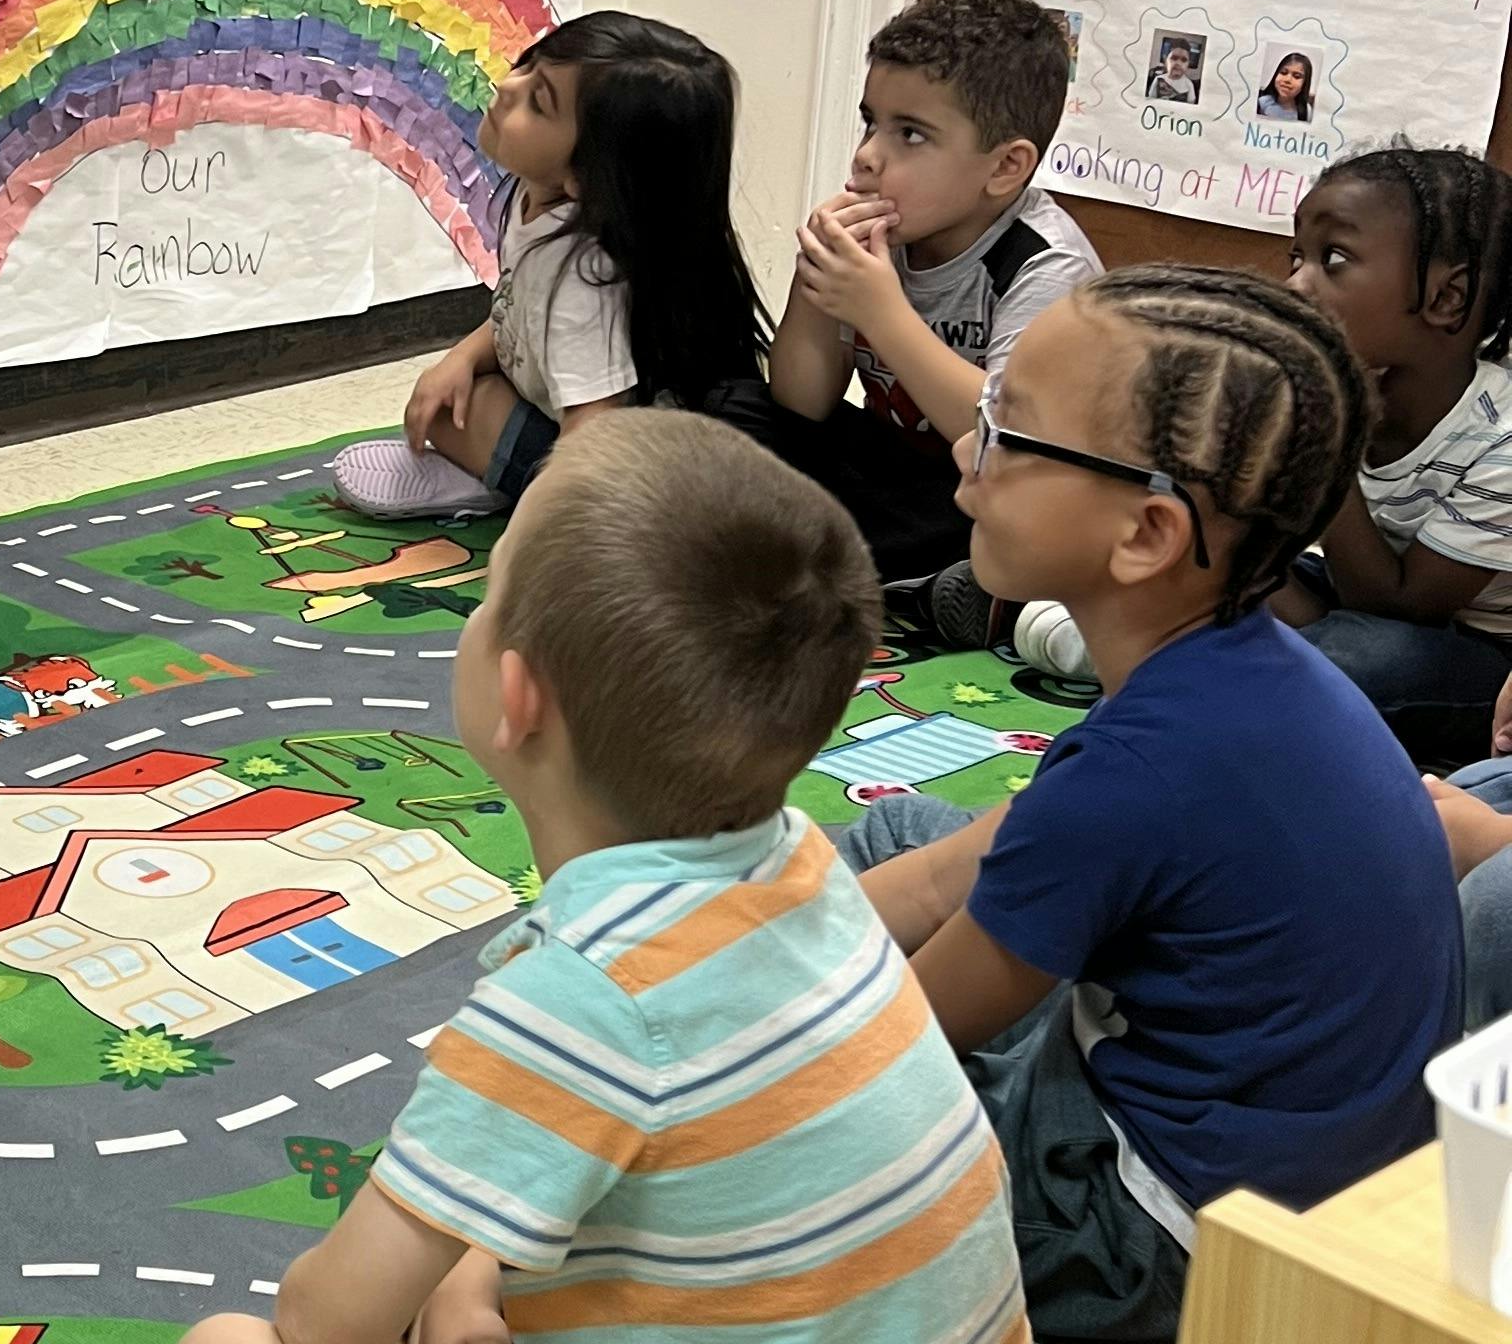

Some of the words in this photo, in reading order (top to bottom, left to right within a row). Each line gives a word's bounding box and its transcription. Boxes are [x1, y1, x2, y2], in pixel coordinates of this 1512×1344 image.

[1140, 105, 1204, 138] Orion
[1243, 121, 1330, 162] Natalia
[140, 147, 226, 194] Our
[1041, 135, 1165, 208] ooking
[1179, 164, 1221, 202] at
[91, 216, 270, 289] Rainbow
